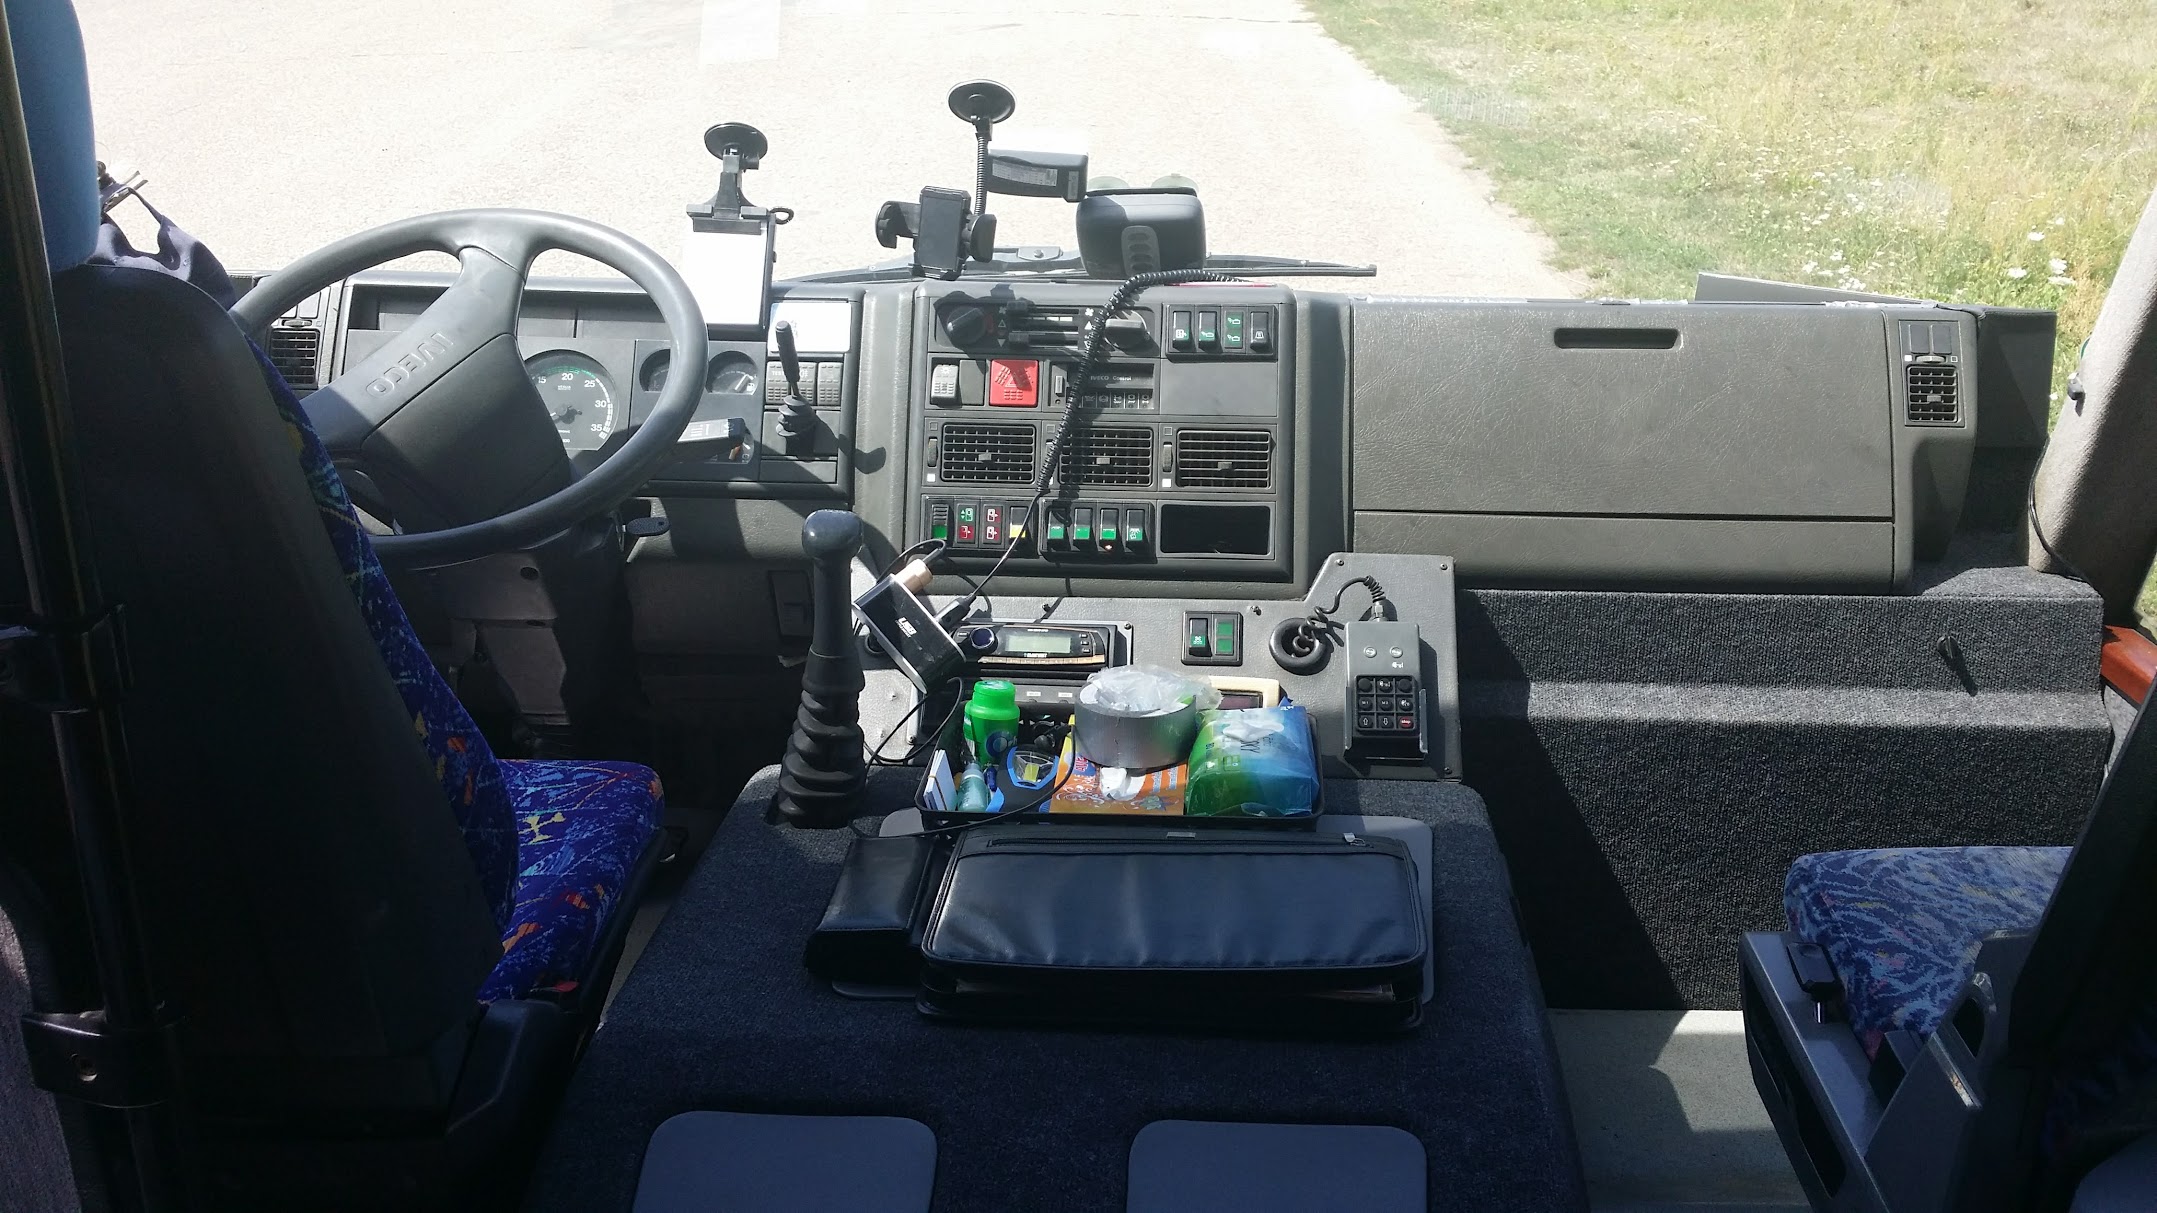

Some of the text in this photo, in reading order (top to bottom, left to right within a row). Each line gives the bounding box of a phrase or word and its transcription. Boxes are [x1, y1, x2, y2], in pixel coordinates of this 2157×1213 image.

[366, 332, 454, 399] IVECO
[538, 375, 547, 384] 15
[561, 372, 573, 380] 20
[584, 379, 596, 388] 25
[594, 399, 607, 408] 30
[590, 423, 603, 432] 35
[897, 616, 918, 636] USB
